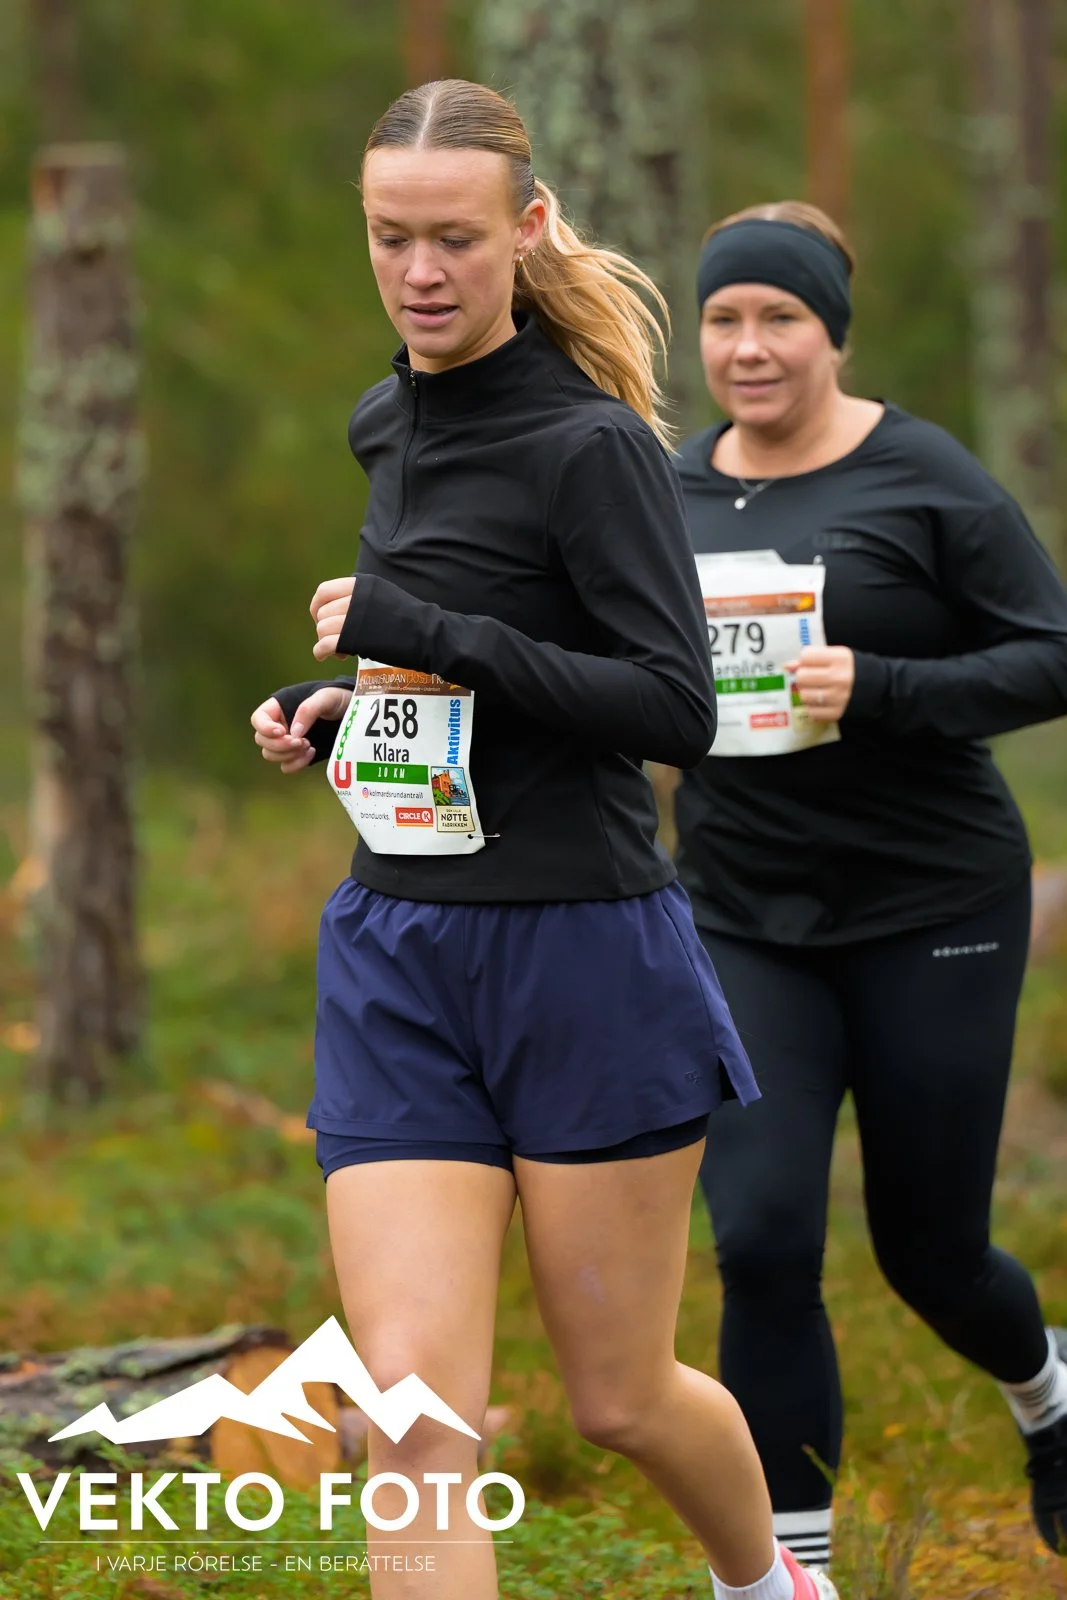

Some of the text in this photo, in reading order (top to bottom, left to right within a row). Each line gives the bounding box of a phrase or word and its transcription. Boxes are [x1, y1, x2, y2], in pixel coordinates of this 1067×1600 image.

[707, 622, 765, 655] 279
[365, 698, 418, 739] 258
[447, 699, 461, 765] Aktivitus
[373, 743, 410, 762] Klara
[377, 767, 405, 779] 10 KM
[398, 812, 421, 820] CIRCLE
